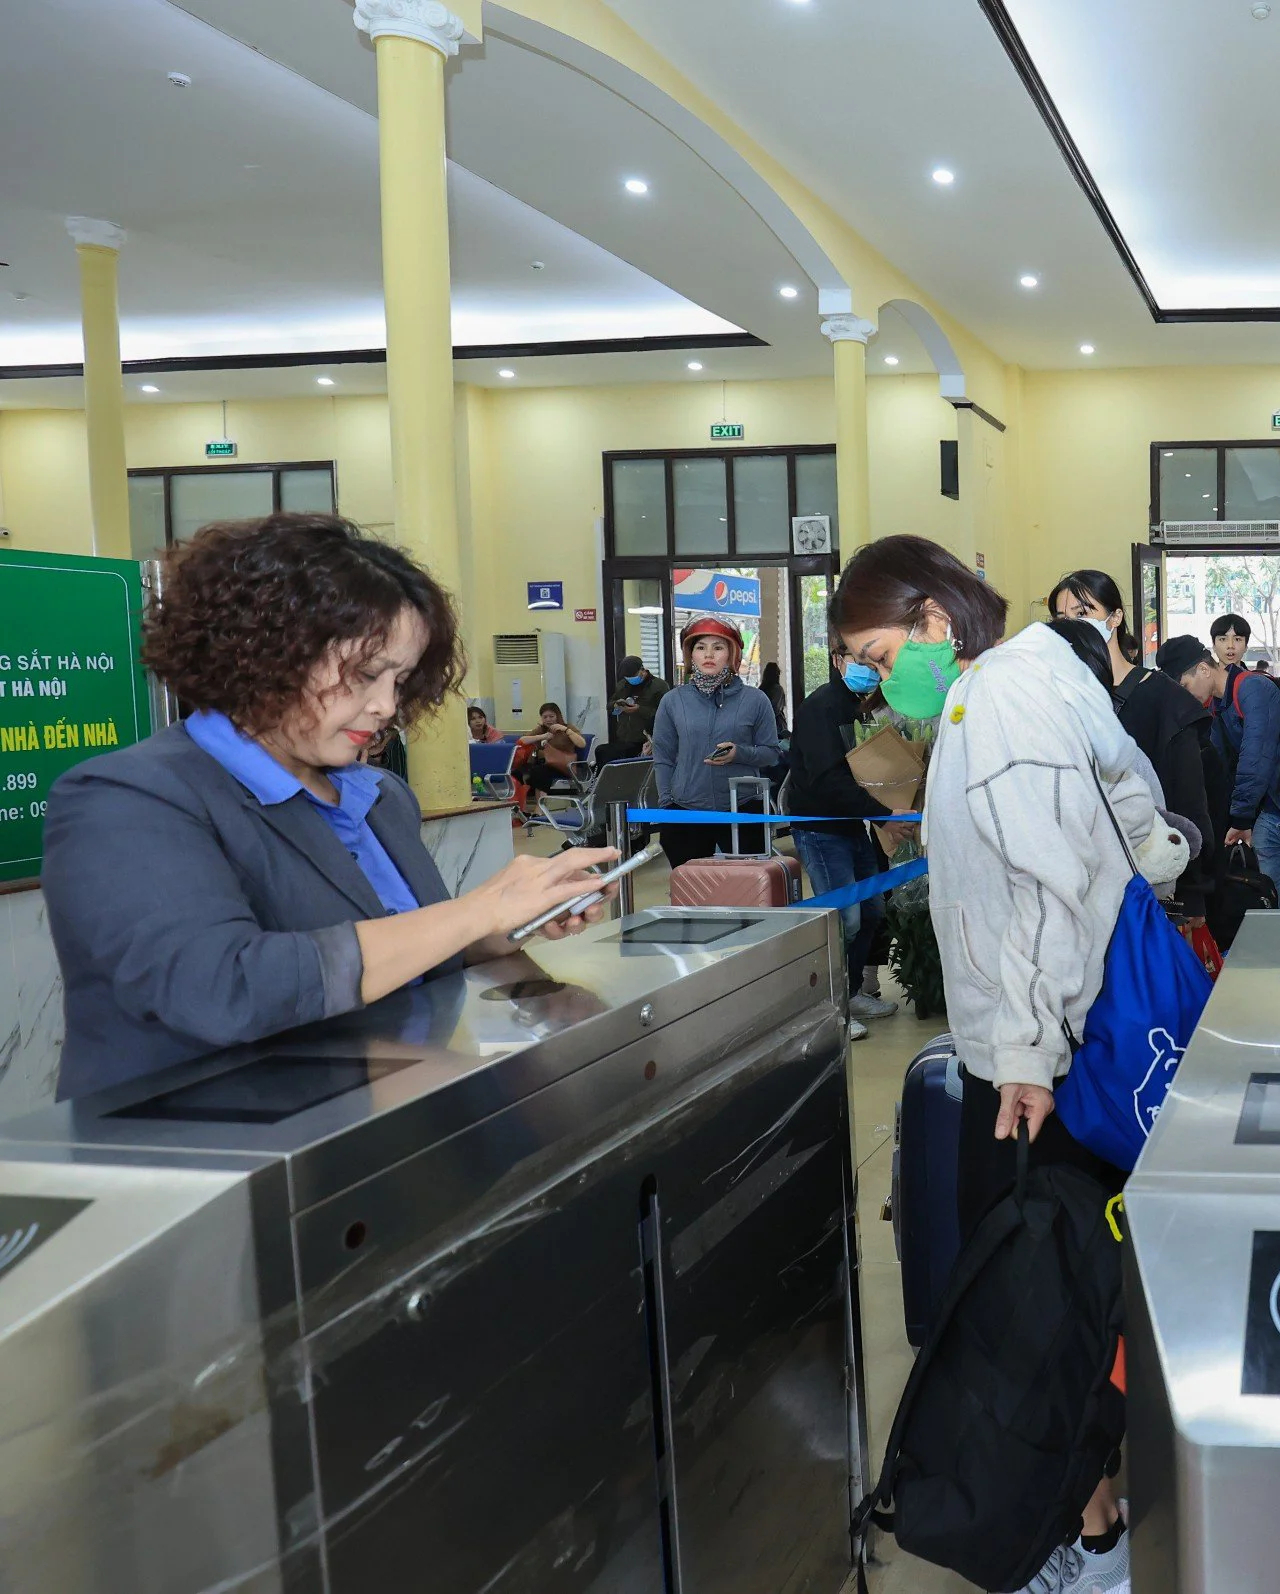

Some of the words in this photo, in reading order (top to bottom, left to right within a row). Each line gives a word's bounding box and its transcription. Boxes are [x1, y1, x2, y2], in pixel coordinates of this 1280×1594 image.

[712, 425, 741, 437] EXIT
[730, 589, 757, 606] pepsi
[17, 649, 52, 671] SẮT
[57, 651, 82, 670] HÀ
[86, 652, 114, 673] NỘI
[11, 677, 35, 697] HÀ
[38, 676, 67, 699] NỘI
[0, 720, 40, 752] NHÀ
[43, 716, 79, 750] ĐẾN
[83, 717, 118, 747] NHÀ
